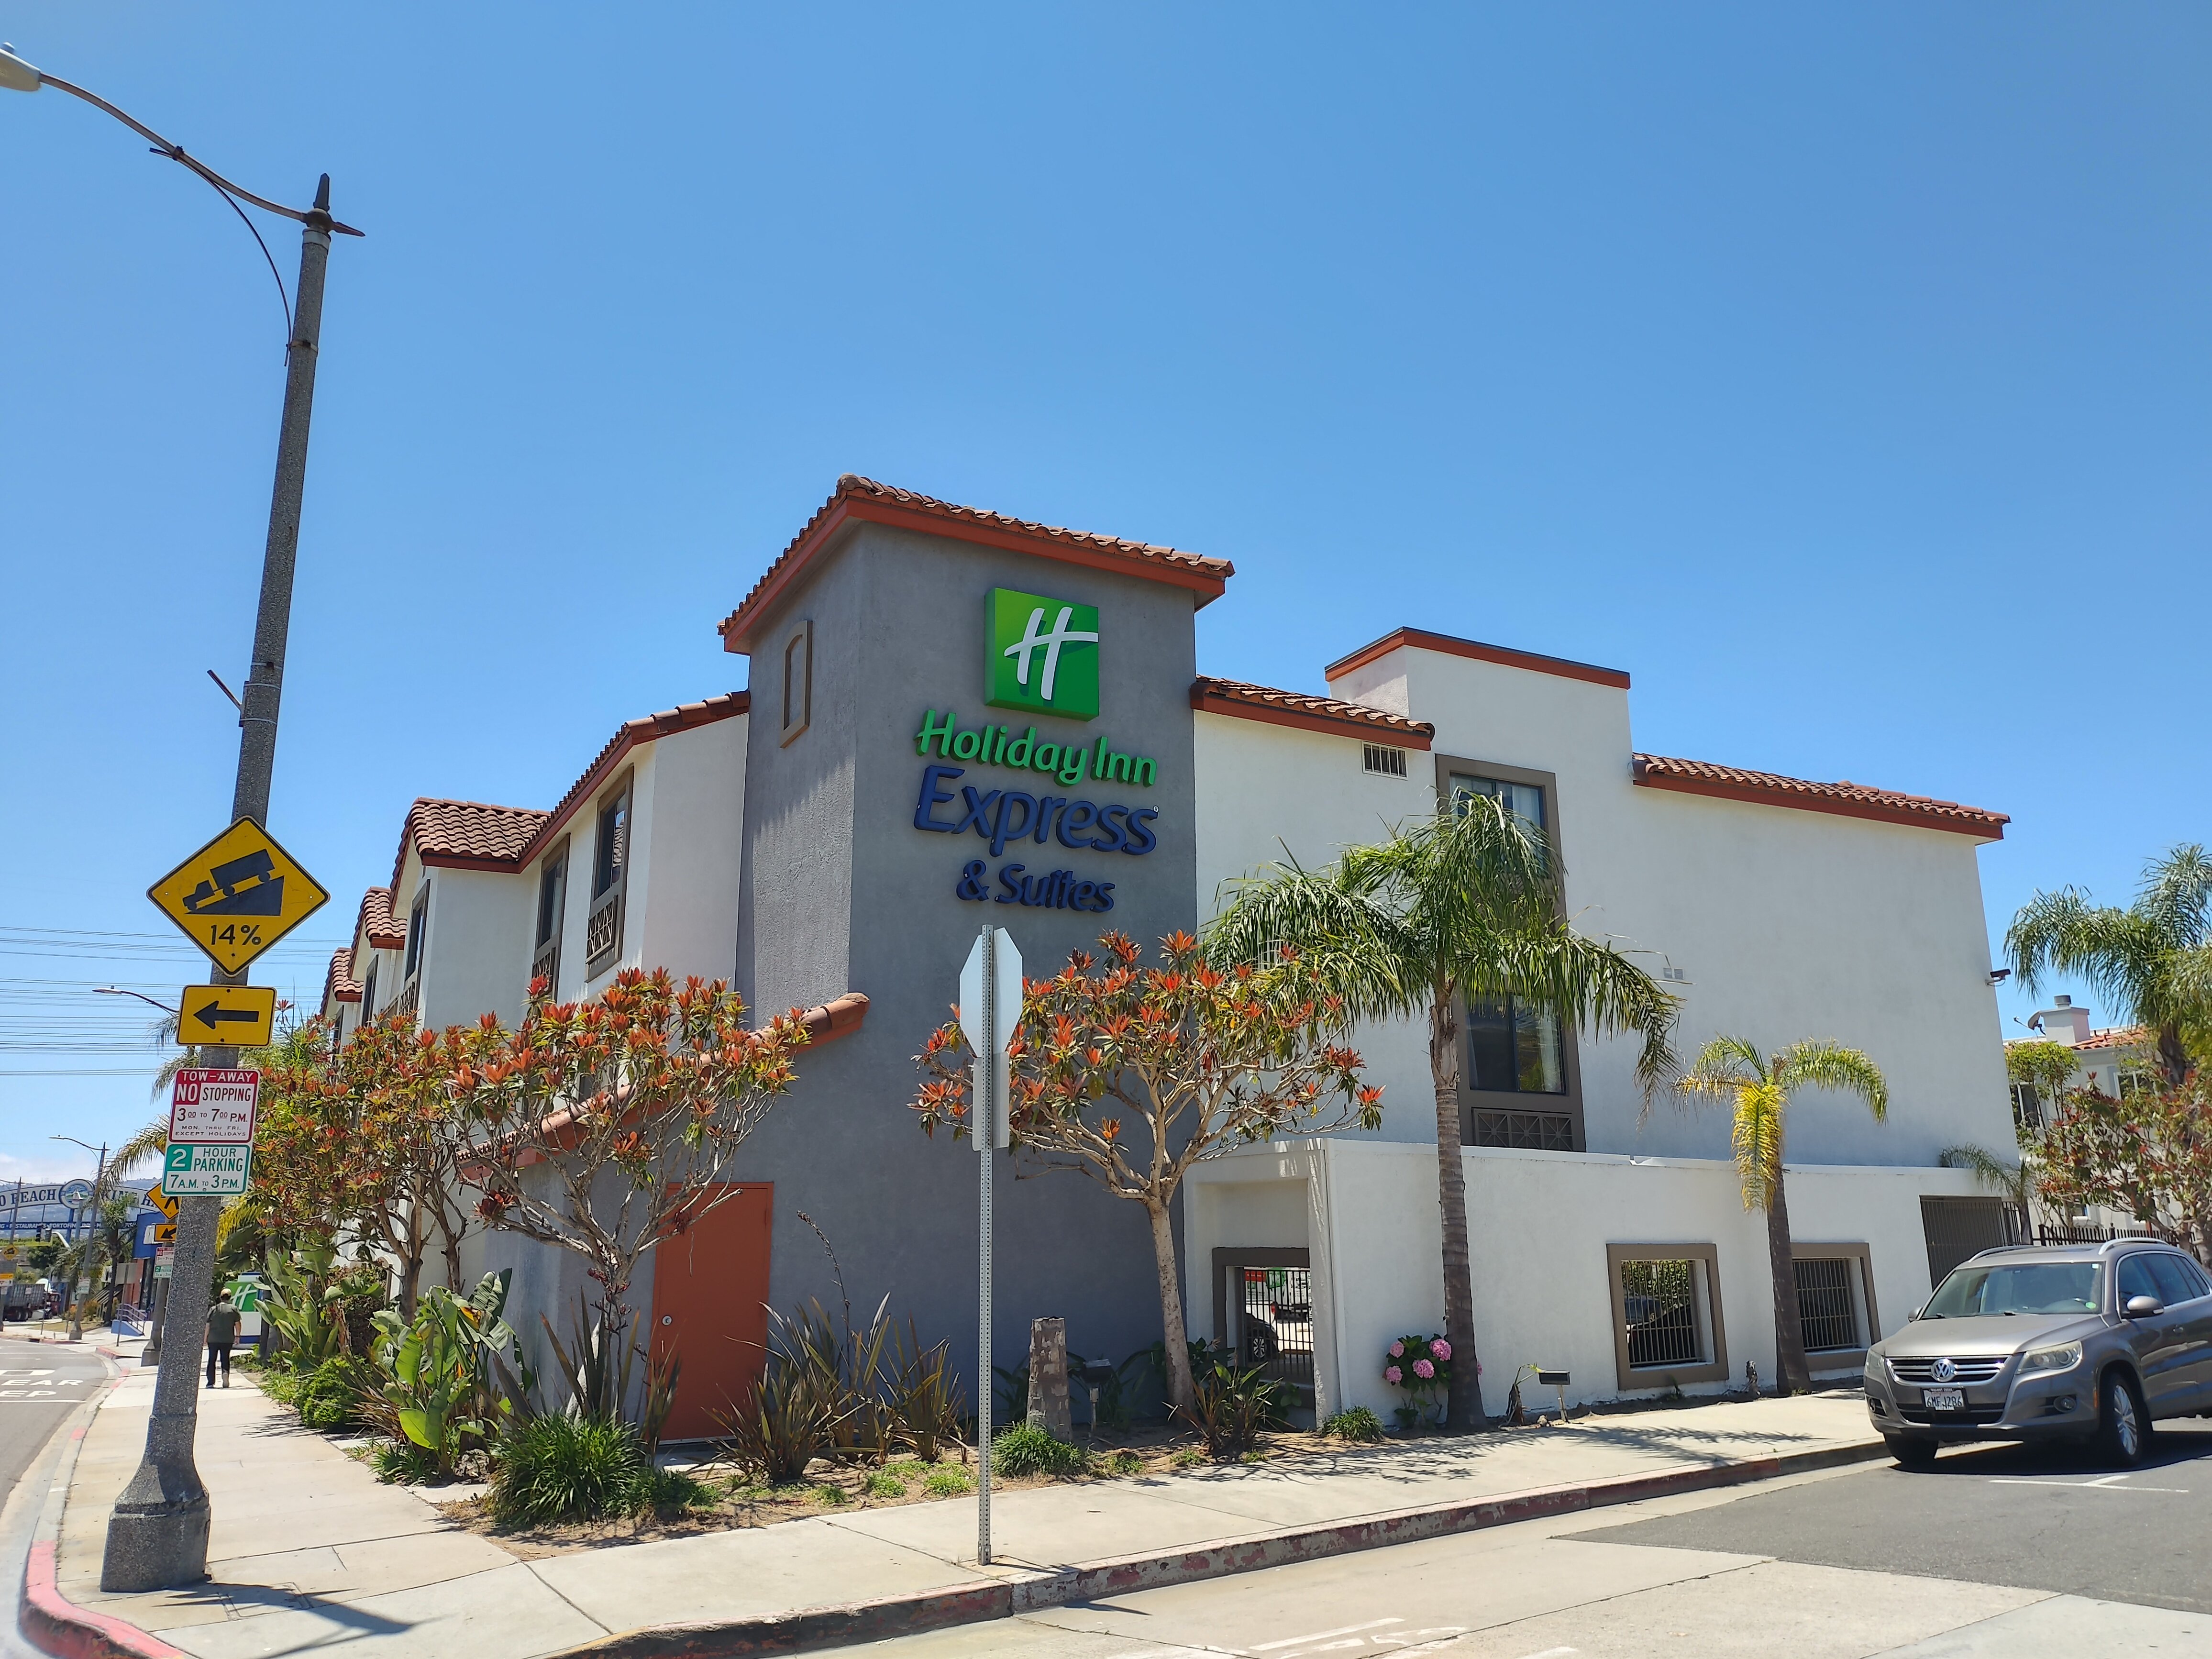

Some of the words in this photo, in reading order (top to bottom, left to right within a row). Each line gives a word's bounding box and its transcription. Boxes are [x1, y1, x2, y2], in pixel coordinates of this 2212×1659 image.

[914, 710, 1088, 788] Holiday
[1090, 736, 1157, 787] Inn
[914, 765, 1158, 858] Express
[956, 859, 990, 902] &
[994, 863, 1116, 913] Suites
[210, 924, 262, 945] 14%
[182, 1071, 254, 1083] TOW-AWAY
[176, 1084, 198, 1102] NO
[202, 1087, 251, 1101] STOPPING
[230, 1113, 248, 1122] P.M.
[171, 1149, 187, 1167] 2
[203, 1148, 236, 1157] HOUR
[194, 1158, 243, 1172] PARKING
[11, 1189, 56, 1205] BEACH
[1927, 1396, 1962, 1407] 6MFJ286
